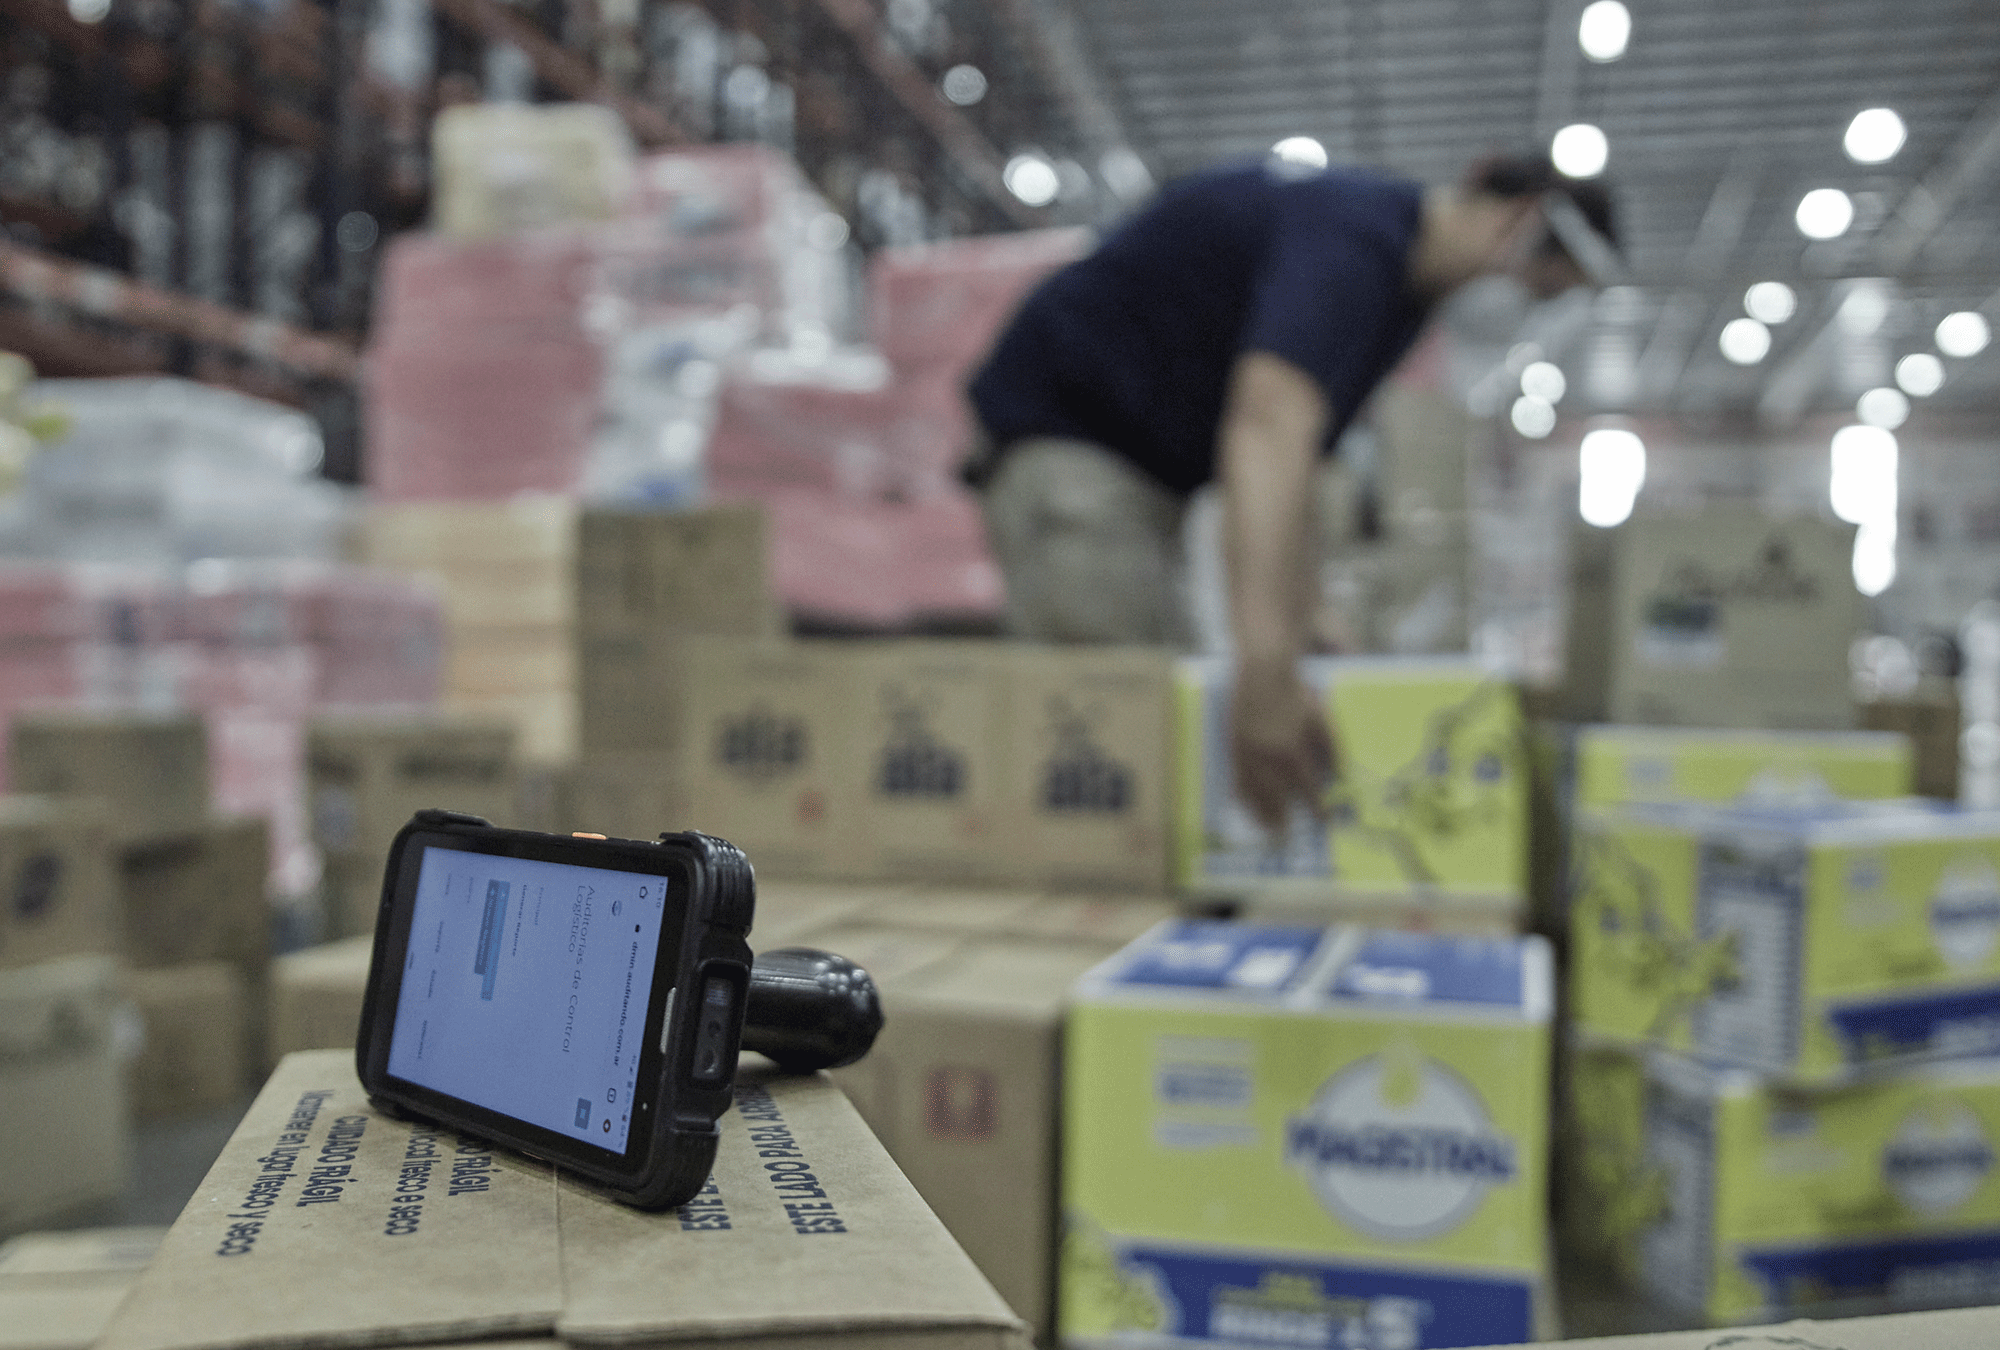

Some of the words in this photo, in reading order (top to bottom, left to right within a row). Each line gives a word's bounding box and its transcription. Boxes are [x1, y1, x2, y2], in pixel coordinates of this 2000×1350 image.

[572, 969, 581, 989] de
[562, 994, 578, 1053] Control
[276, 1132, 308, 1146] en
[317, 1115, 369, 1163] CUIDADO
[405, 1134, 444, 1159] local
[747, 1124, 804, 1157] PARA
[257, 1145, 310, 1172] lugar
[241, 1173, 298, 1209] fresco
[296, 1164, 358, 1208] FRÁGIL
[396, 1160, 441, 1193] fresco
[448, 1156, 502, 1196] FRÁGIL
[764, 1161, 827, 1199] LADO
[226, 1209, 270, 1218] y
[392, 1194, 425, 1203] e
[383, 1205, 423, 1236] seco
[783, 1202, 848, 1234] ESTE
[215, 1221, 264, 1257] seco
